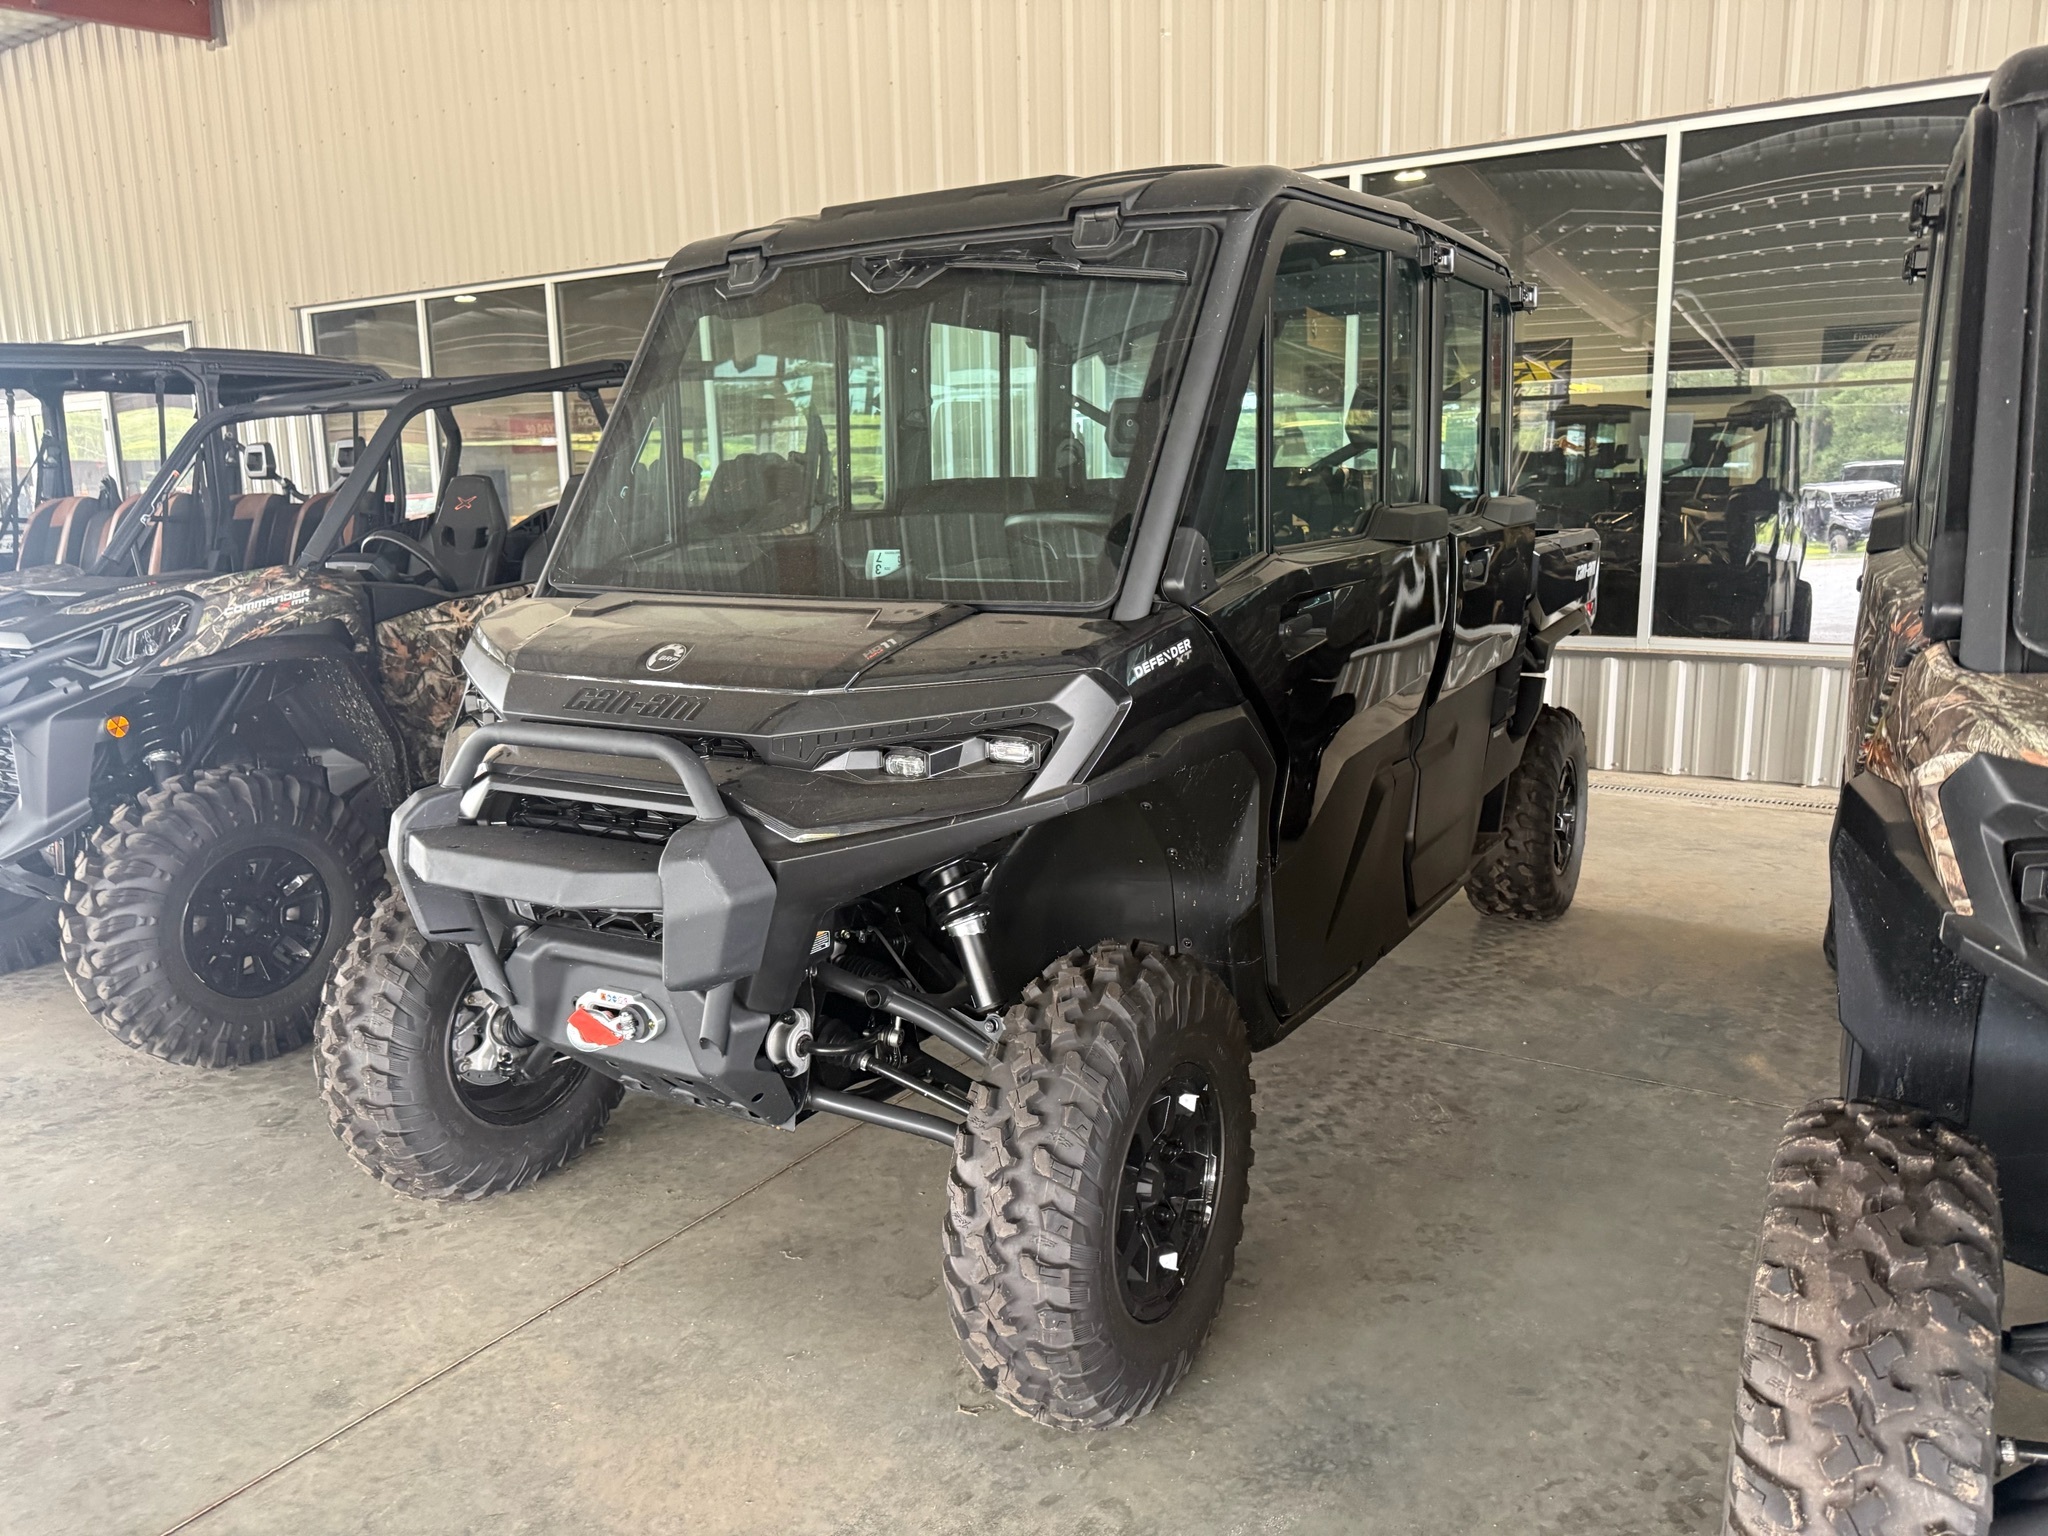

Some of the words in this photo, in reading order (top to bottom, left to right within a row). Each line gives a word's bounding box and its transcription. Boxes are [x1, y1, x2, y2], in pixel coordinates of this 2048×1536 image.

[223, 588, 311, 617] COMMANDER
[657, 654, 679, 663] BRP
[1133, 638, 1193, 680] DEFENDER
[1174, 649, 1193, 668] XT
